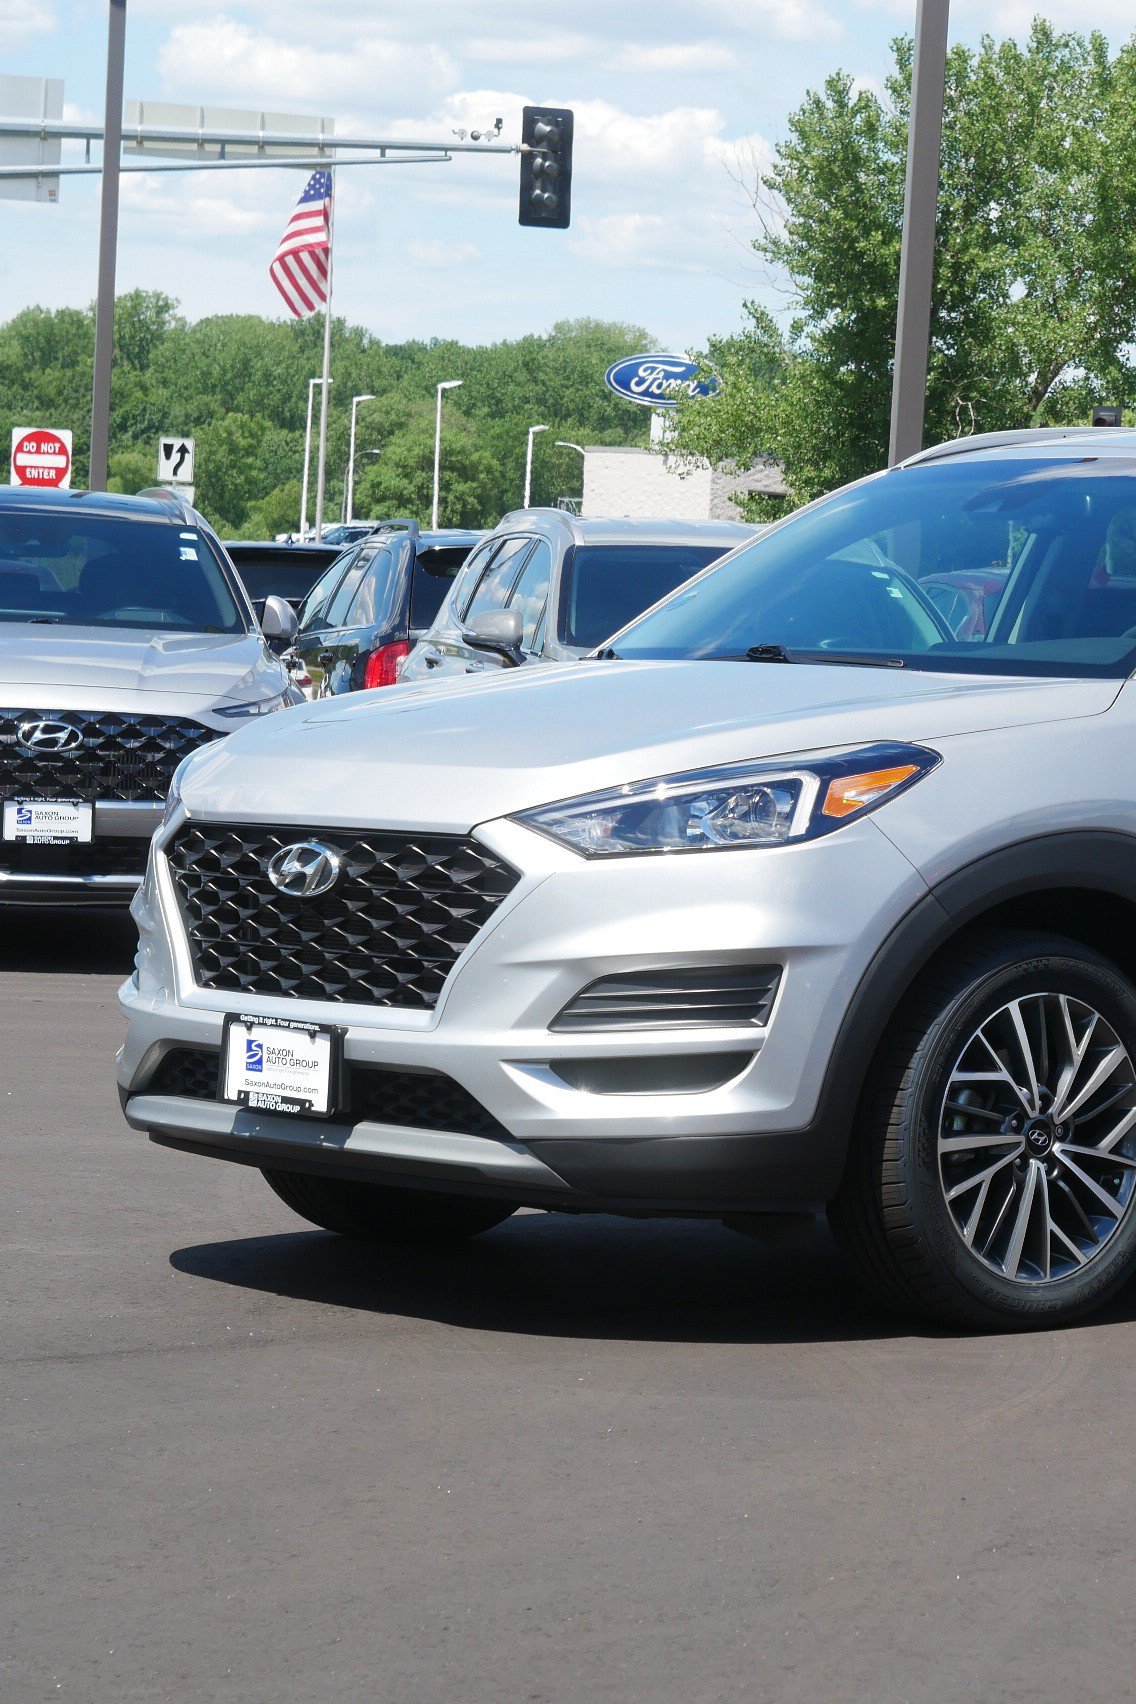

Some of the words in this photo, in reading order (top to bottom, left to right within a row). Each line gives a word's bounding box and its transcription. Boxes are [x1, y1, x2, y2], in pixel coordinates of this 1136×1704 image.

[23, 441, 37, 453] DO
[40, 442, 61, 453] NOT
[26, 468, 56, 479] ENTER
[277, 1018, 290, 1027] Four
[266, 1046, 294, 1058] SAXON
[266, 1055, 288, 1066] AUTO
[289, 1058, 319, 1069] GROUP
[244, 1078, 319, 1094] SaxonAutoGroup.com
[257, 1092, 282, 1103] SAXON
[257, 1100, 276, 1109] AUTO
[276, 1103, 301, 1113] GROUP
